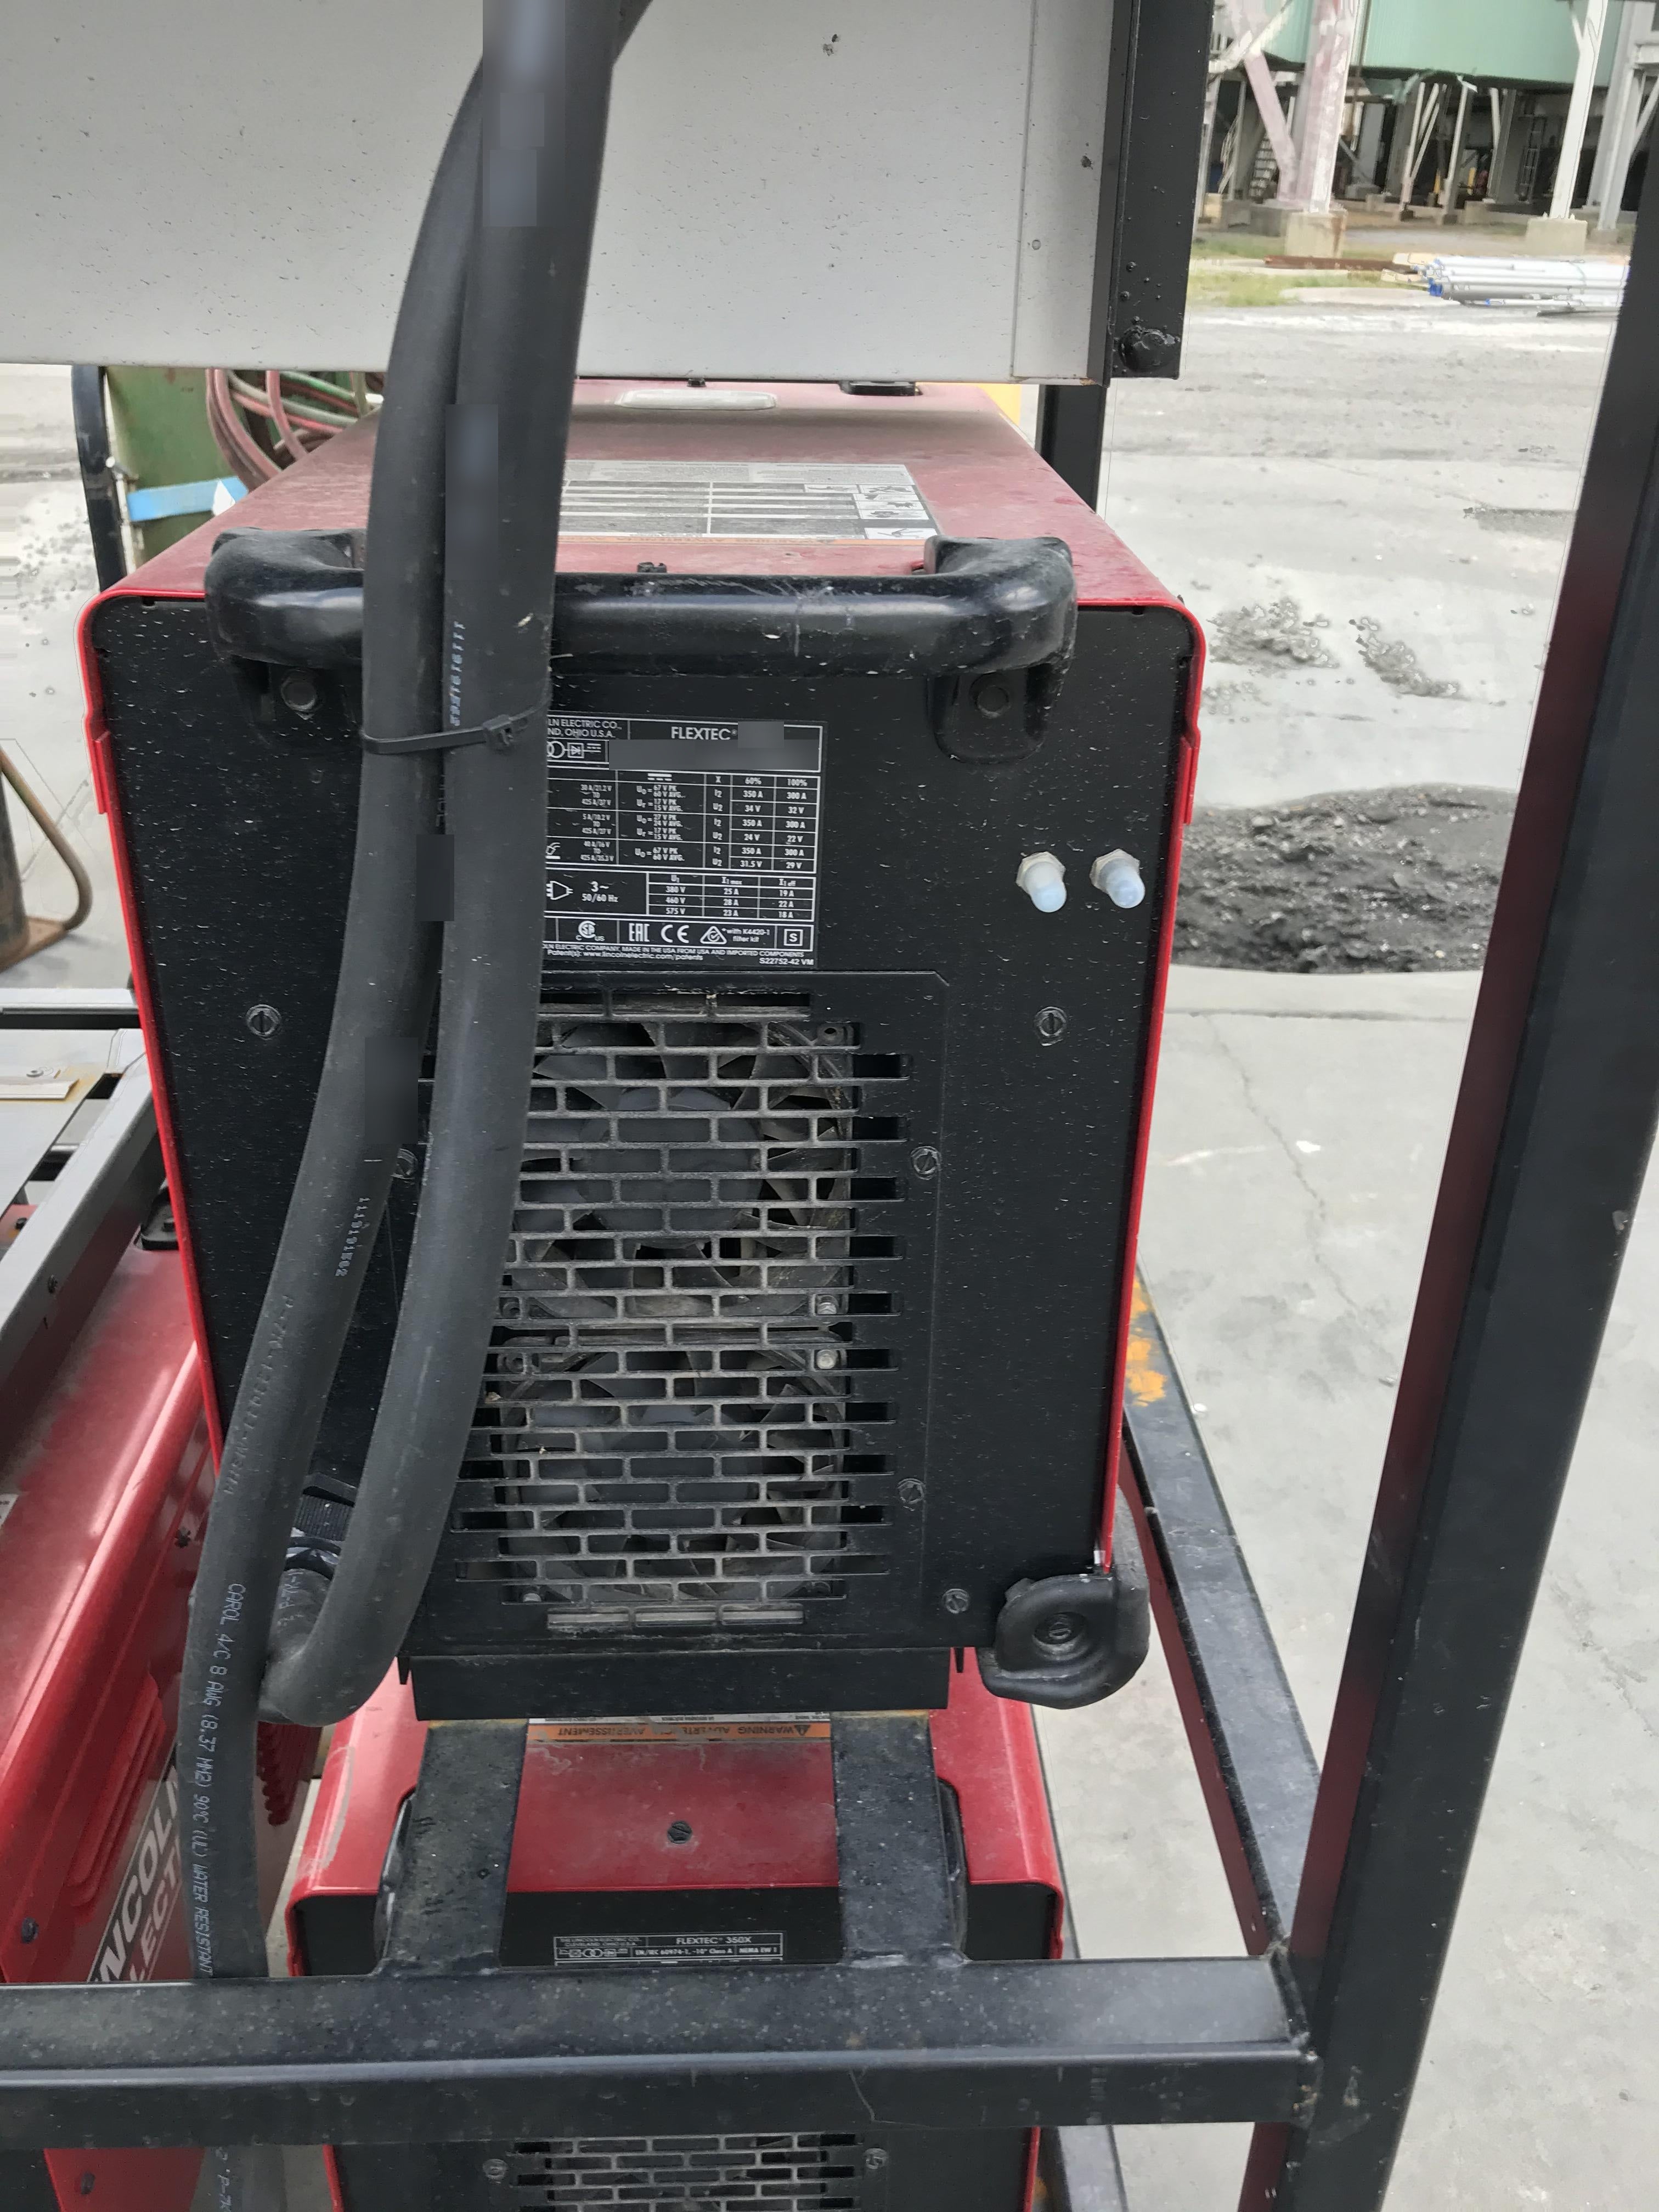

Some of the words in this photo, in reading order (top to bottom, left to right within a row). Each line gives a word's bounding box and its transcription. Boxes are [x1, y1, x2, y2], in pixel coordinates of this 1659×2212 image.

[561, 719, 601, 729] ELECTRIC
[787, 778, 808, 787] 100%
[582, 893, 607, 903] 50/60
[608, 894, 619, 902] Hz
[661, 924, 690, 943] CE
[789, 933, 798, 943] S
[220, 1583, 246, 1625] CAROL
[213, 1633, 235, 1660] 4/C
[210, 1666, 228, 1675] 8
[204, 1680, 225, 1707] AWG
[198, 1714, 221, 1753] (8.37
[737, 1725, 795, 1735] WARNING
[193, 1864, 208, 1903] WATER
[194, 1906, 214, 1976] RESISTANT
